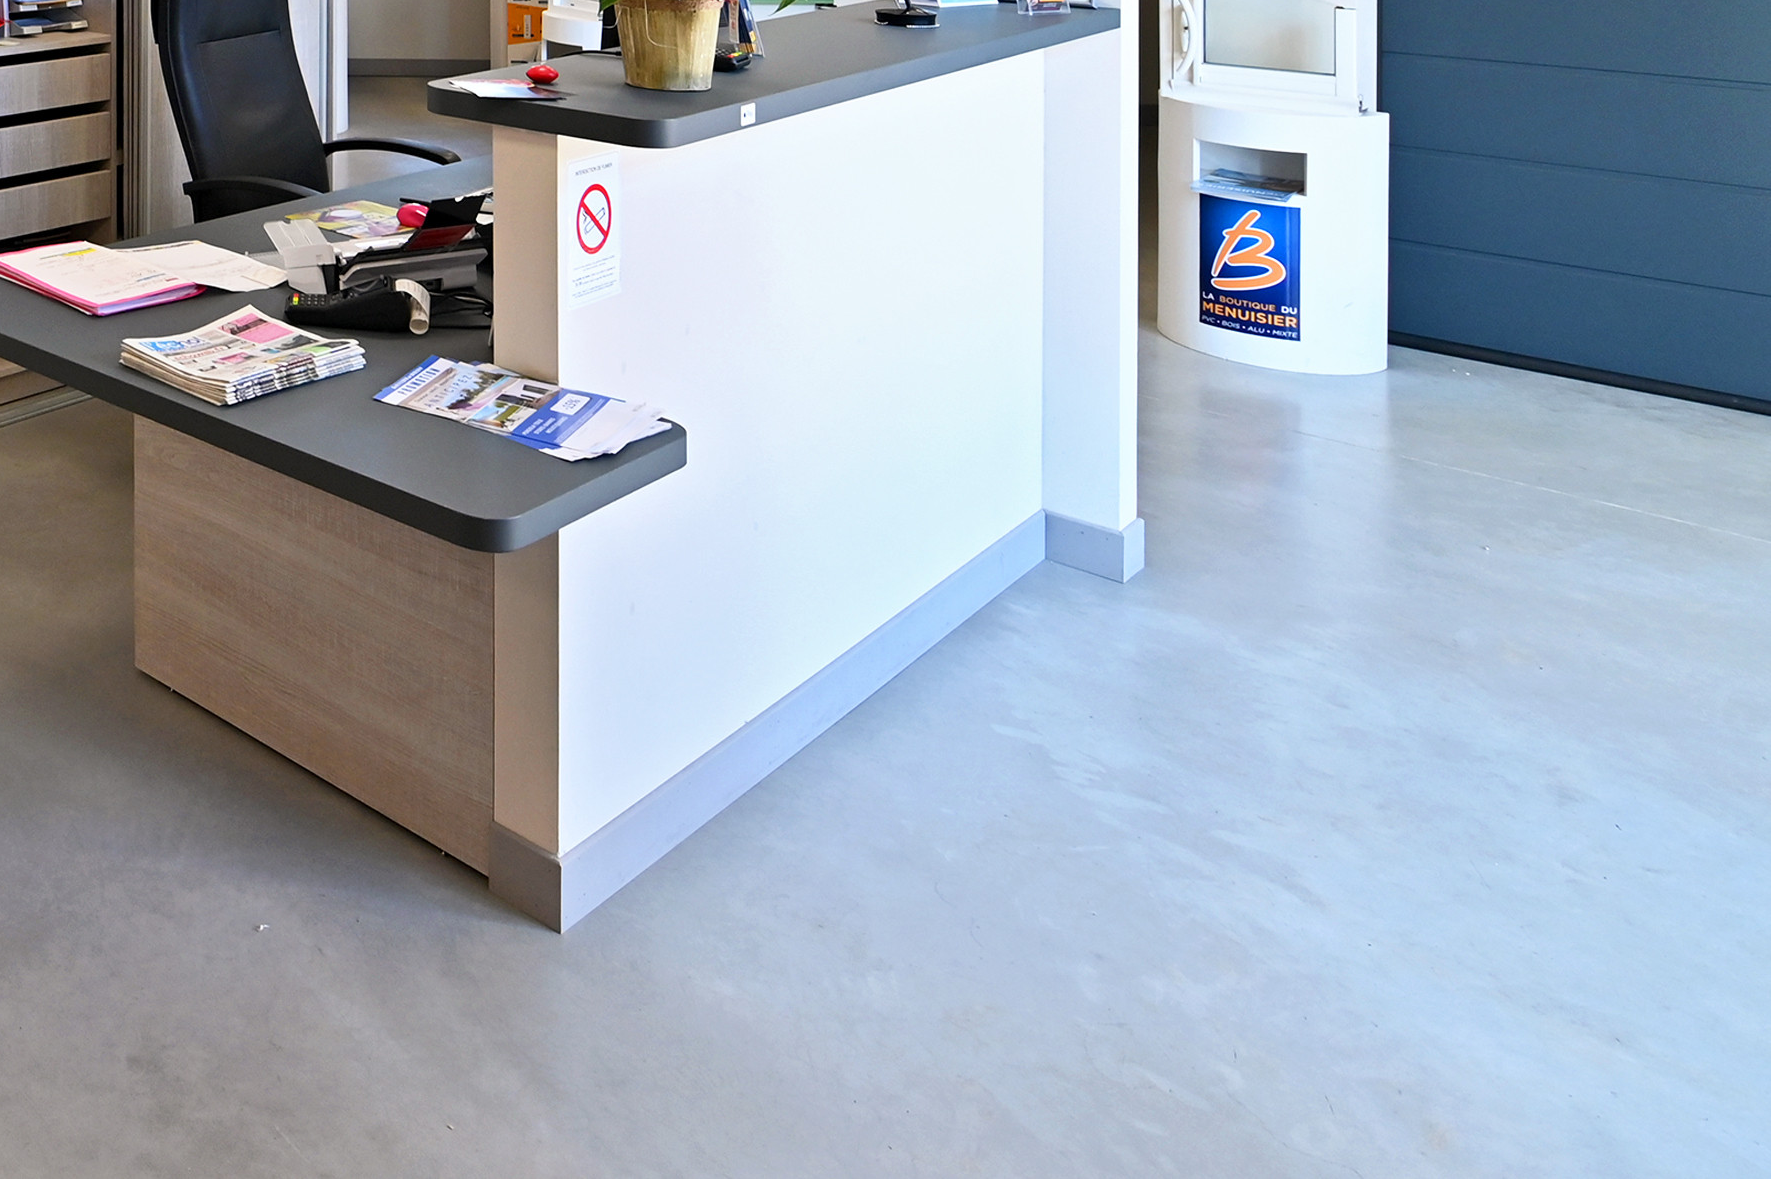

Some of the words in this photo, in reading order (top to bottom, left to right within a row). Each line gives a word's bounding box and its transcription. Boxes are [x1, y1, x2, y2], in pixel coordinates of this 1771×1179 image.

[1202, 291, 1215, 301] LA
[1219, 295, 1276, 312] BOUTIQUE
[1281, 306, 1298, 315] DU
[1202, 301, 1298, 328] MENUISIER
[1201, 315, 1216, 324] PVC
[1221, 320, 1241, 329] BOIS
[1247, 325, 1265, 334] ALU
[1272, 329, 1298, 338] MIXTE
